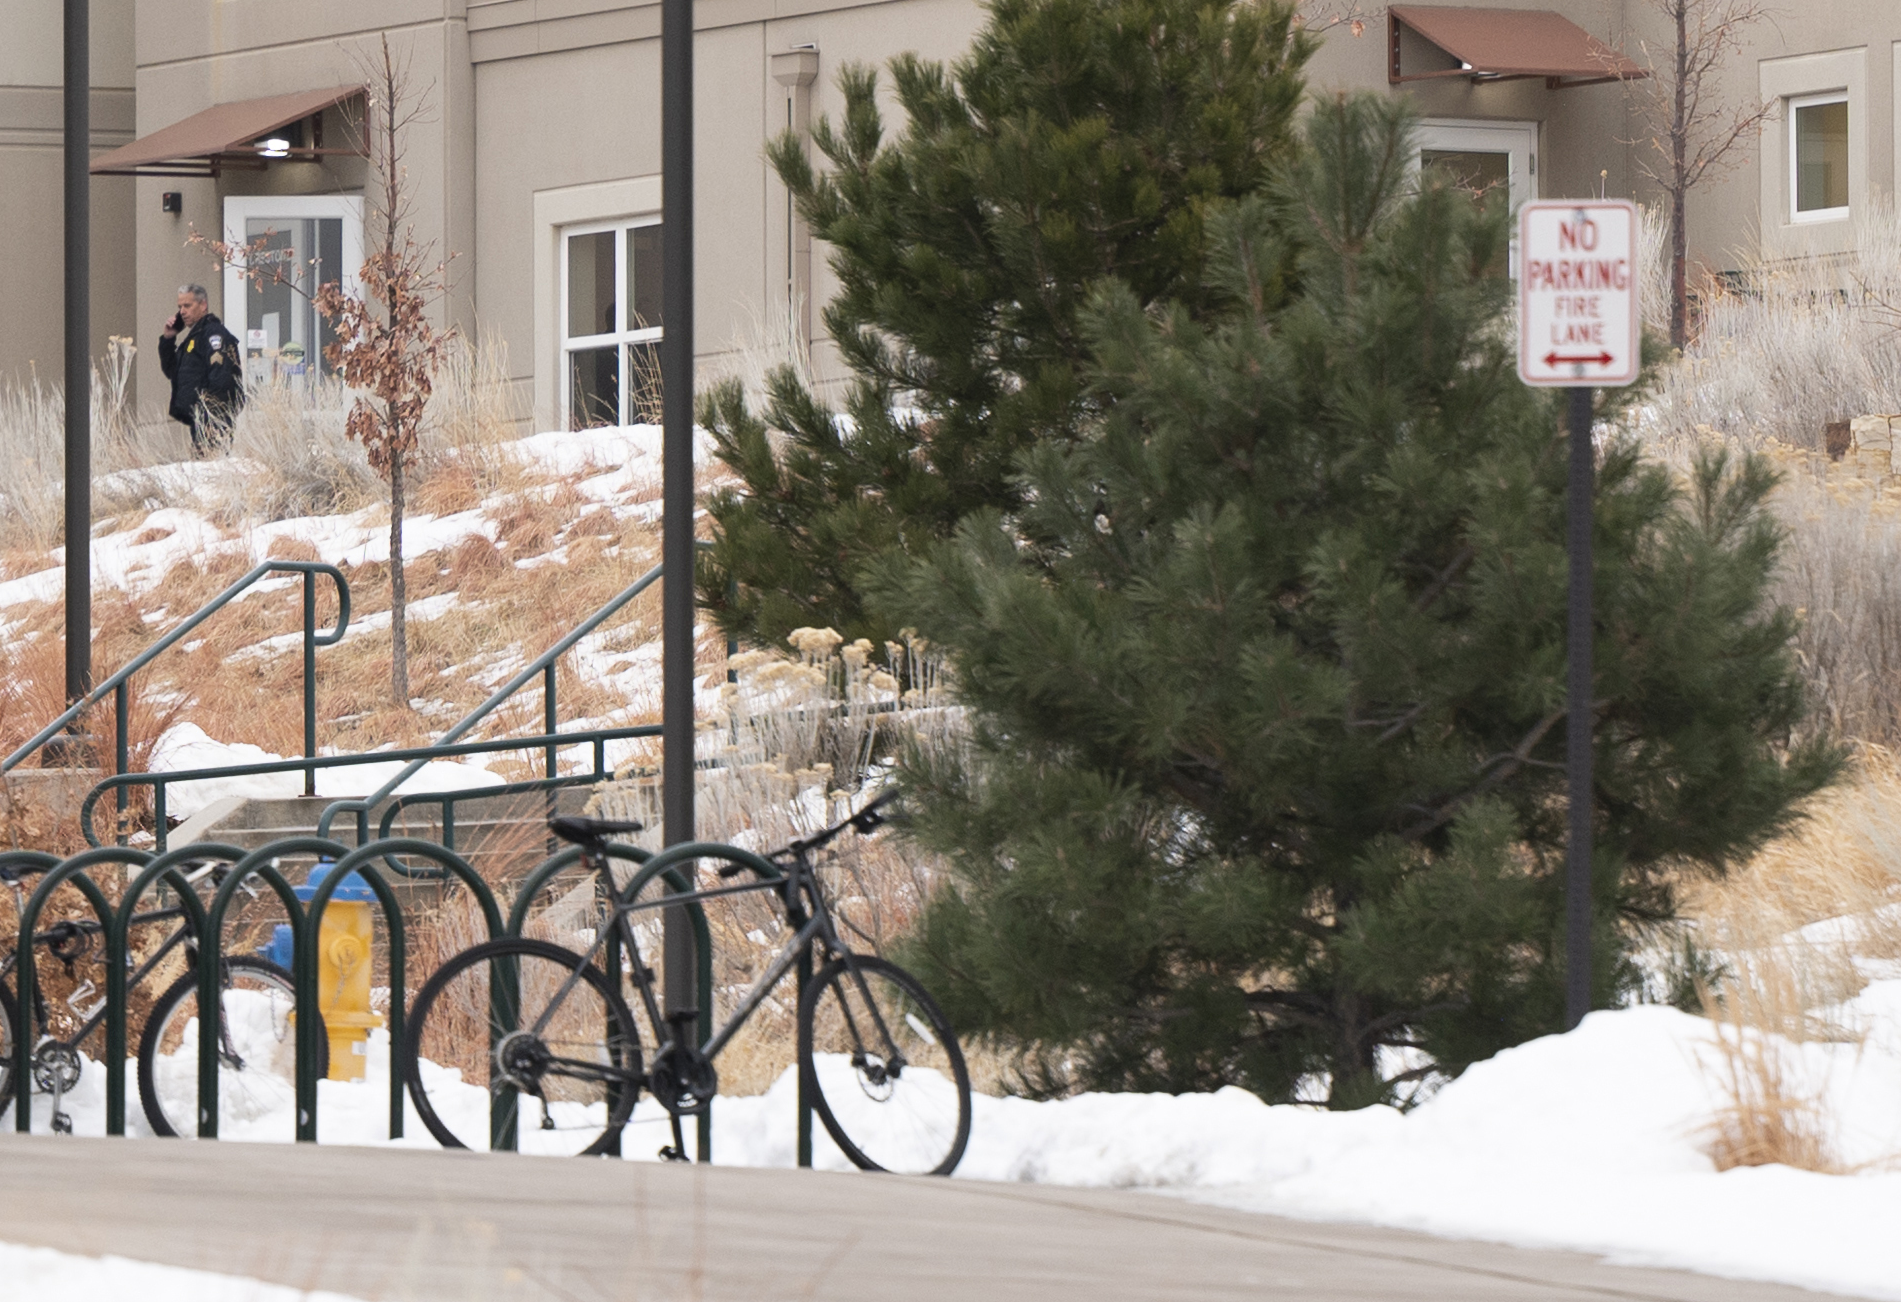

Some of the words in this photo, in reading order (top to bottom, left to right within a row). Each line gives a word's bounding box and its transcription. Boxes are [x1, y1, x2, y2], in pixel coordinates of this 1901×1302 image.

[1559, 220, 1598, 251] NO
[1528, 259, 1627, 291] PARKING
[1554, 295, 1601, 318] FIRE
[1550, 323, 1604, 346] LANE
